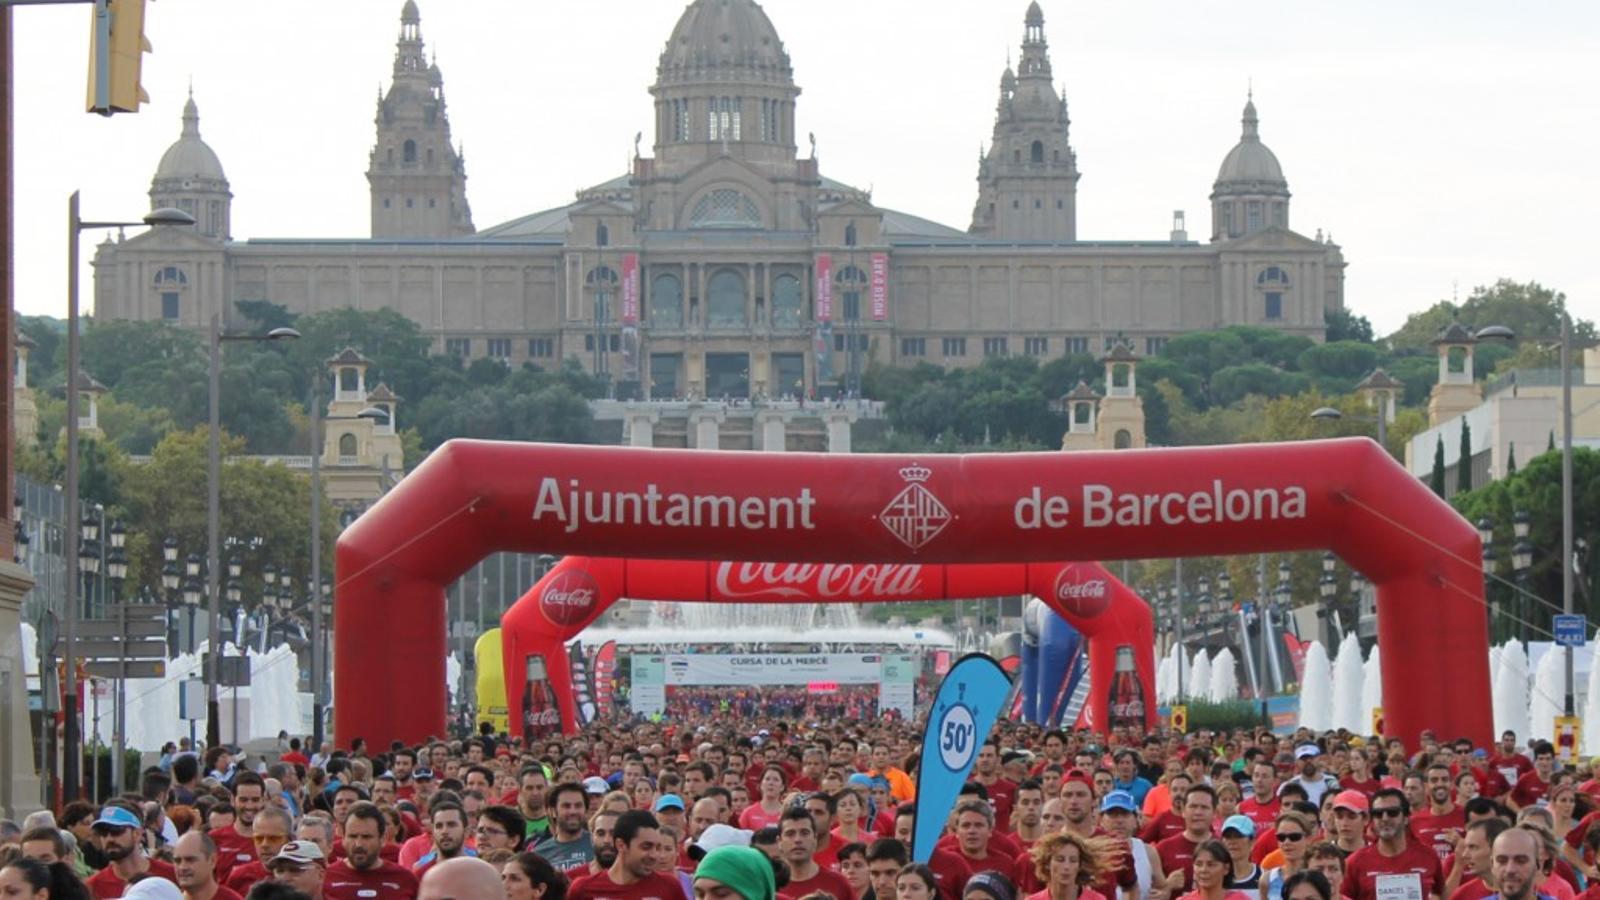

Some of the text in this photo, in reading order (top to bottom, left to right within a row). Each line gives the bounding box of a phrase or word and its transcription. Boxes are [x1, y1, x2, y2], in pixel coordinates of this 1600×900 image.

[532, 477, 816, 533] Ajuntament
[1014, 479, 1306, 529] de Barcelona
